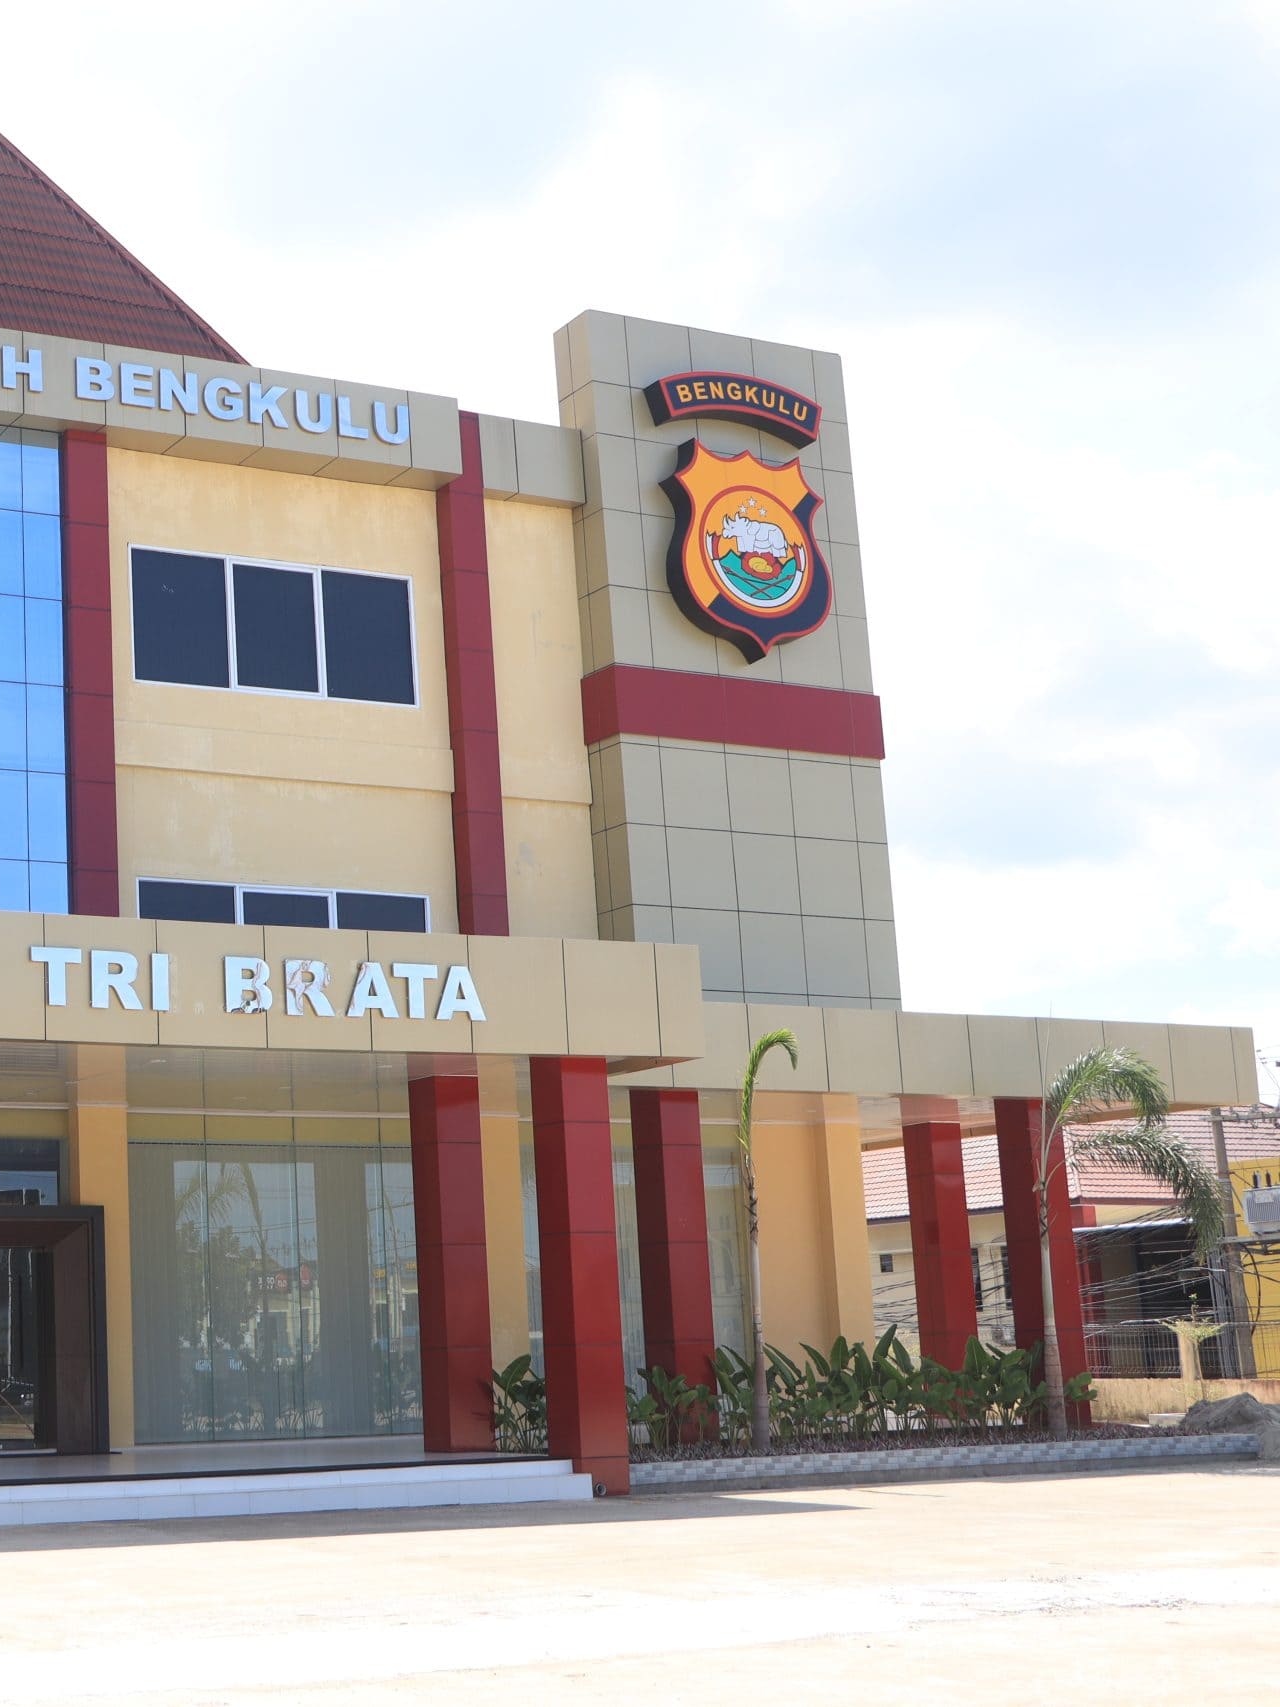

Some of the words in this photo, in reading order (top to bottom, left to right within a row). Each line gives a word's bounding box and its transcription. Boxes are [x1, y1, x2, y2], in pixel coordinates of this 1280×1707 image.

[75, 356, 410, 445] BENGKULU
[675, 381, 808, 421] BENGKULU
[30, 946, 169, 1012] TRI
[223, 955, 487, 1022] BRATA
